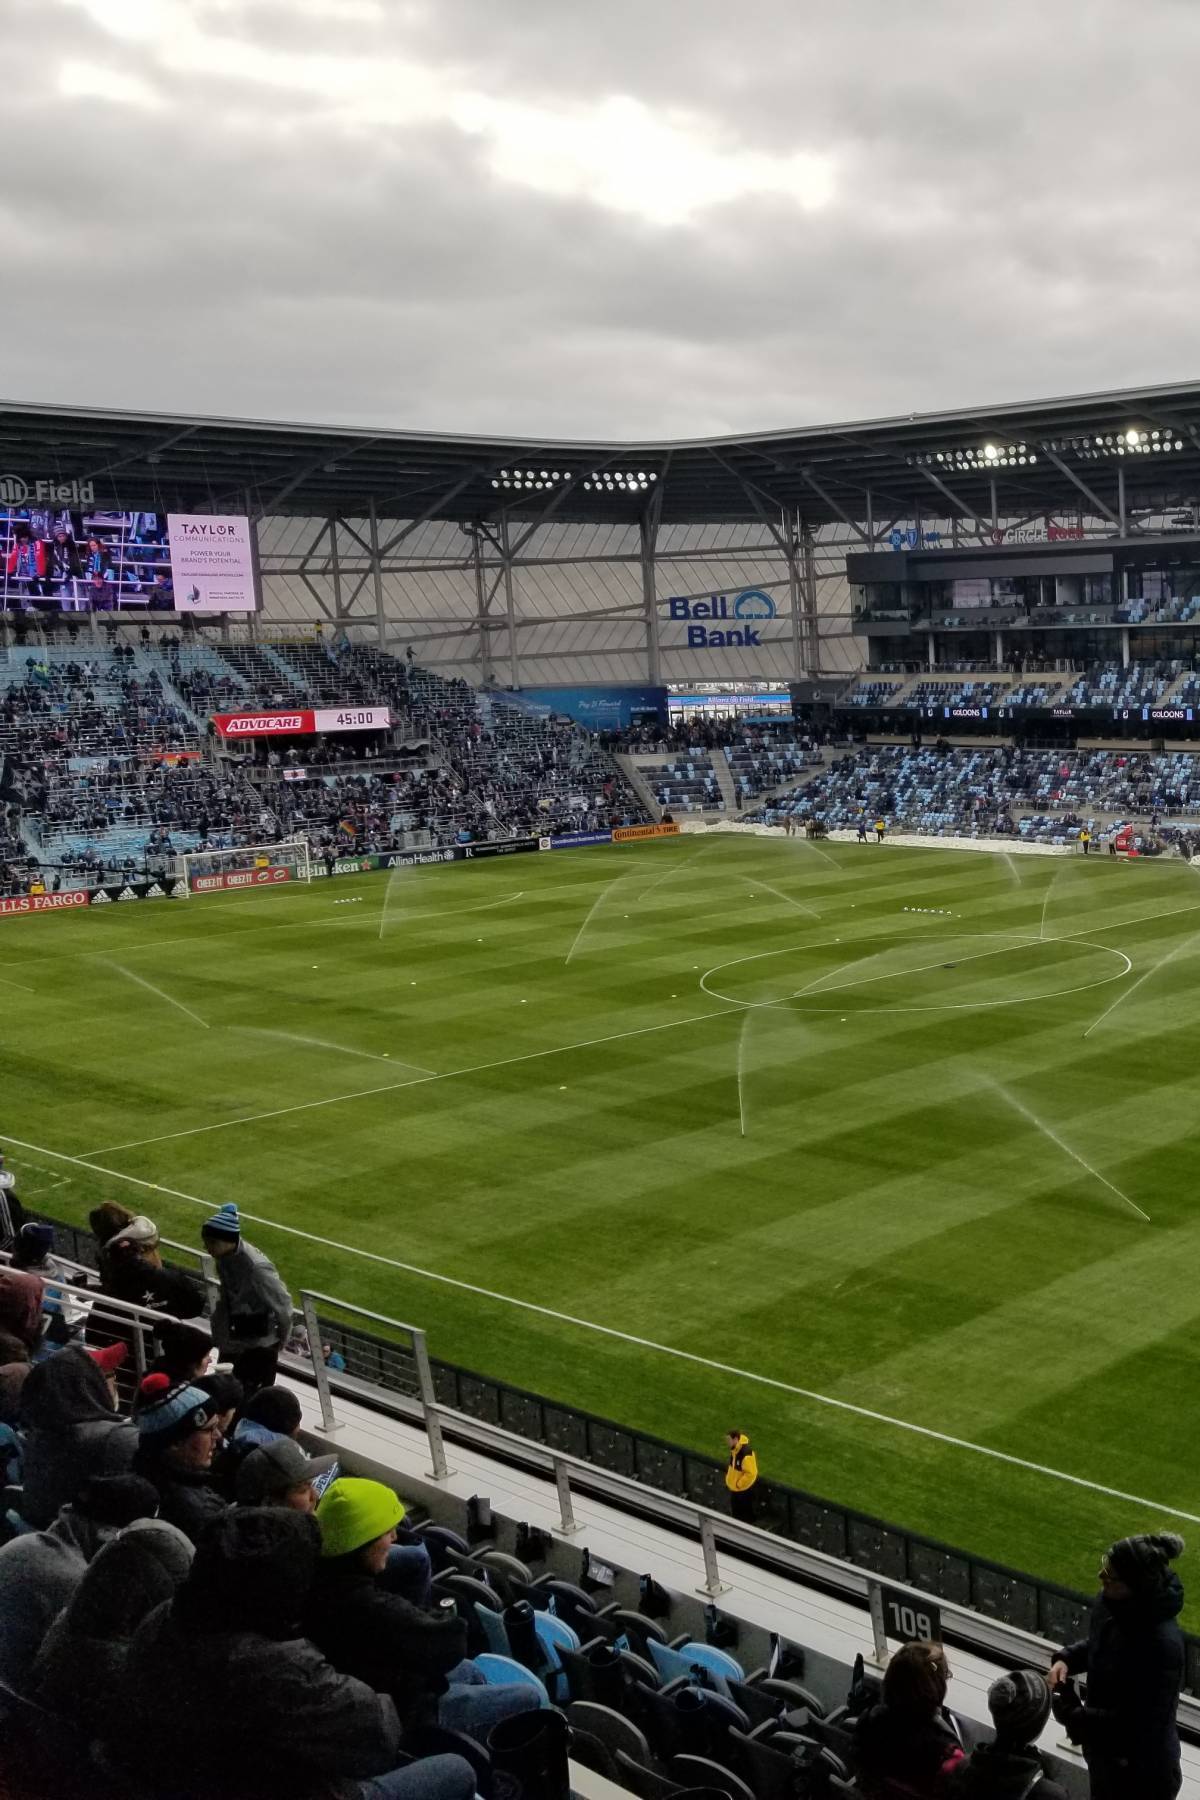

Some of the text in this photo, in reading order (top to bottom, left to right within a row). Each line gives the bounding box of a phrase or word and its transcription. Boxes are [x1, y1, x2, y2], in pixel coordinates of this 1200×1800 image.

[35, 480, 94, 503] Field
[181, 524, 235, 535] TAYLOR
[670, 597, 727, 620] Bell
[687, 625, 761, 648] Bank
[226, 716, 302, 732] ADVOCARE
[336, 712, 373, 725] 45:00
[614, 828, 654, 840] Continental
[387, 853, 443, 867] Allina Health
[33, 893, 85, 908] FARGO
[889, 1602, 932, 1641] 109
